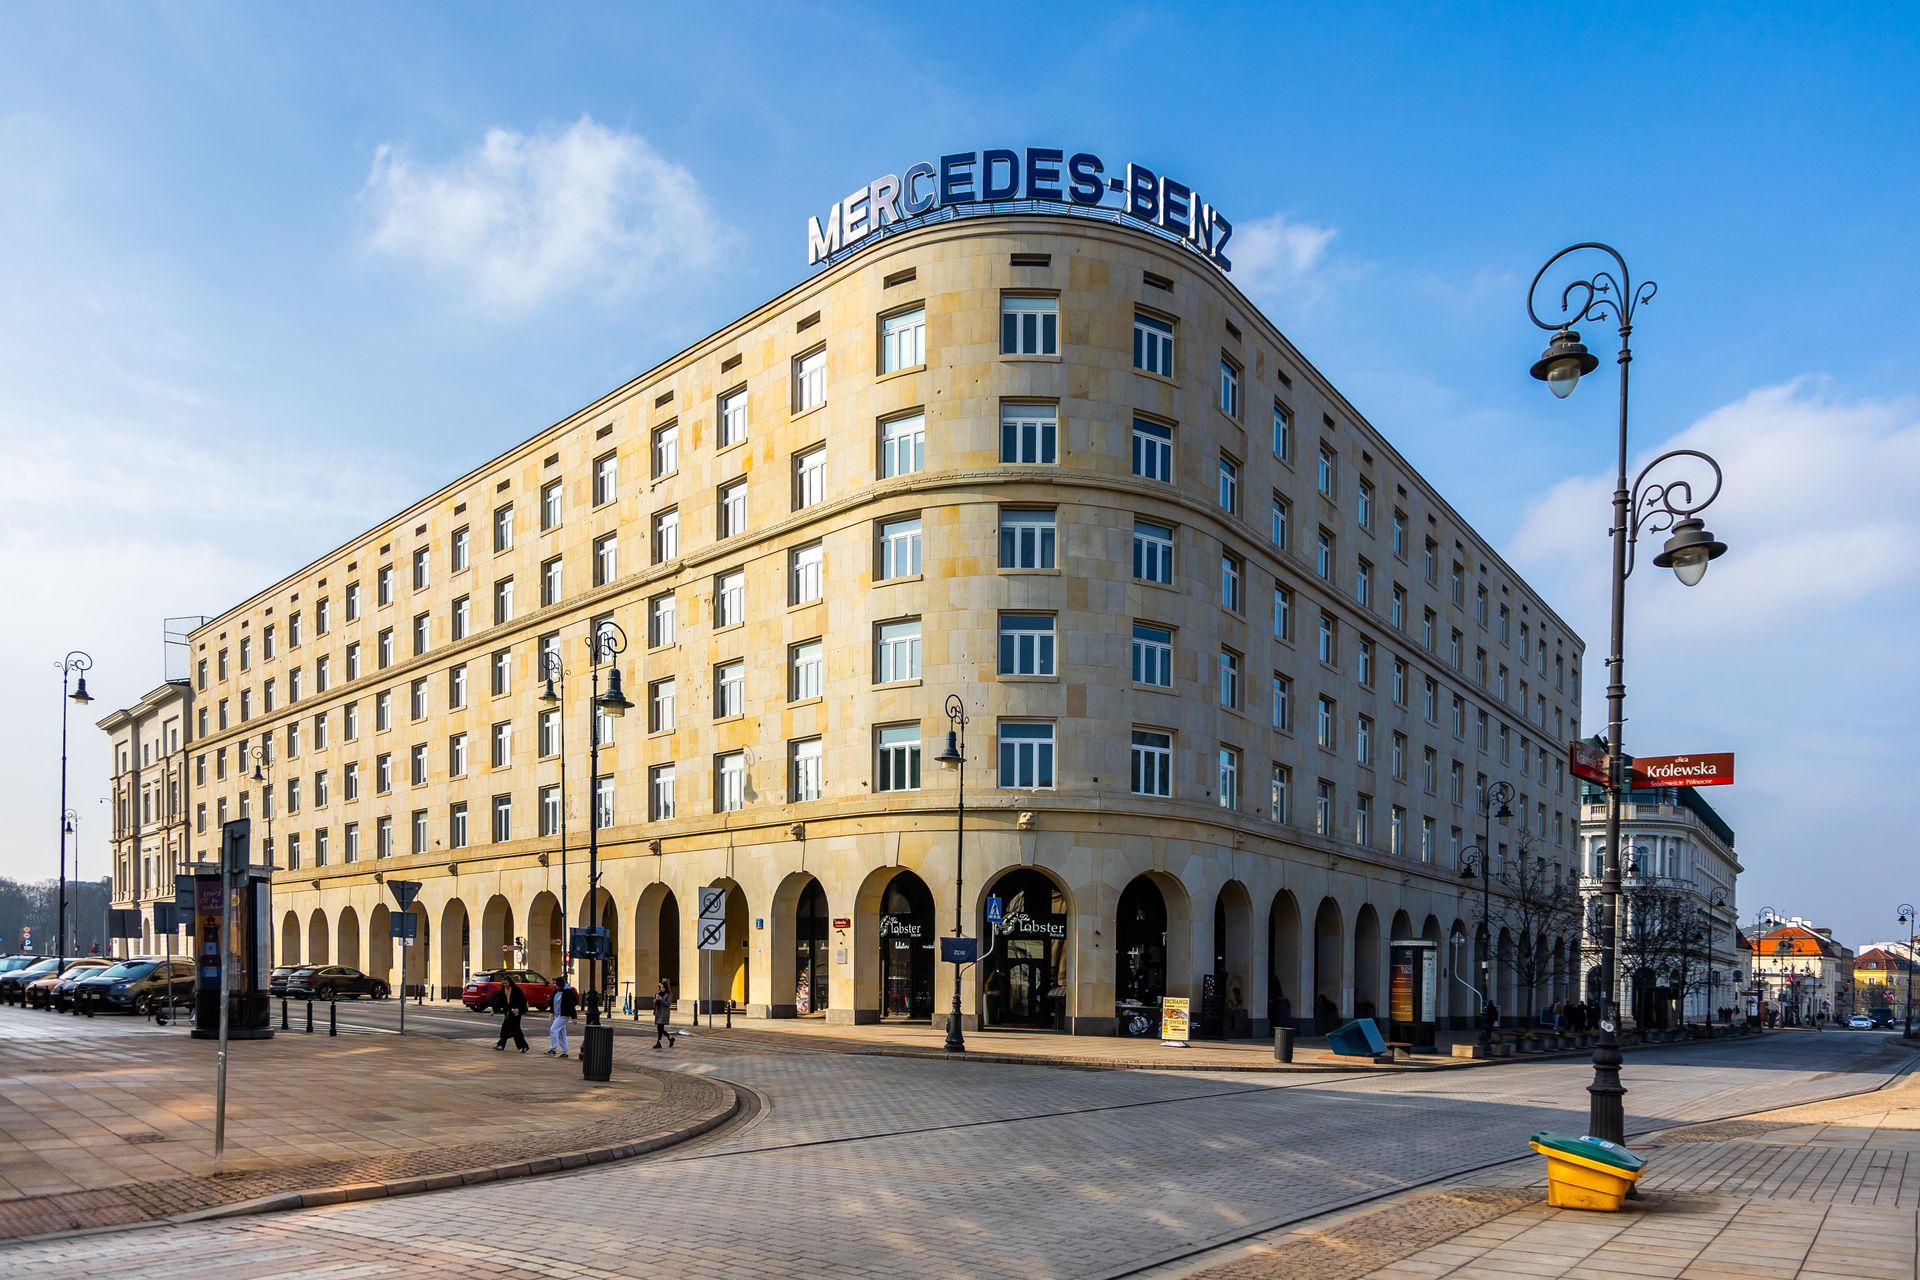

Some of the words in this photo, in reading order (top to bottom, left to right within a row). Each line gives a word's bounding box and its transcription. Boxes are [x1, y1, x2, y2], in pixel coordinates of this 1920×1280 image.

[807, 147, 1233, 272] MERCEDES-BENZ
[1647, 761, 1717, 778] Królewska
[1019, 920, 1065, 934] Lobster
